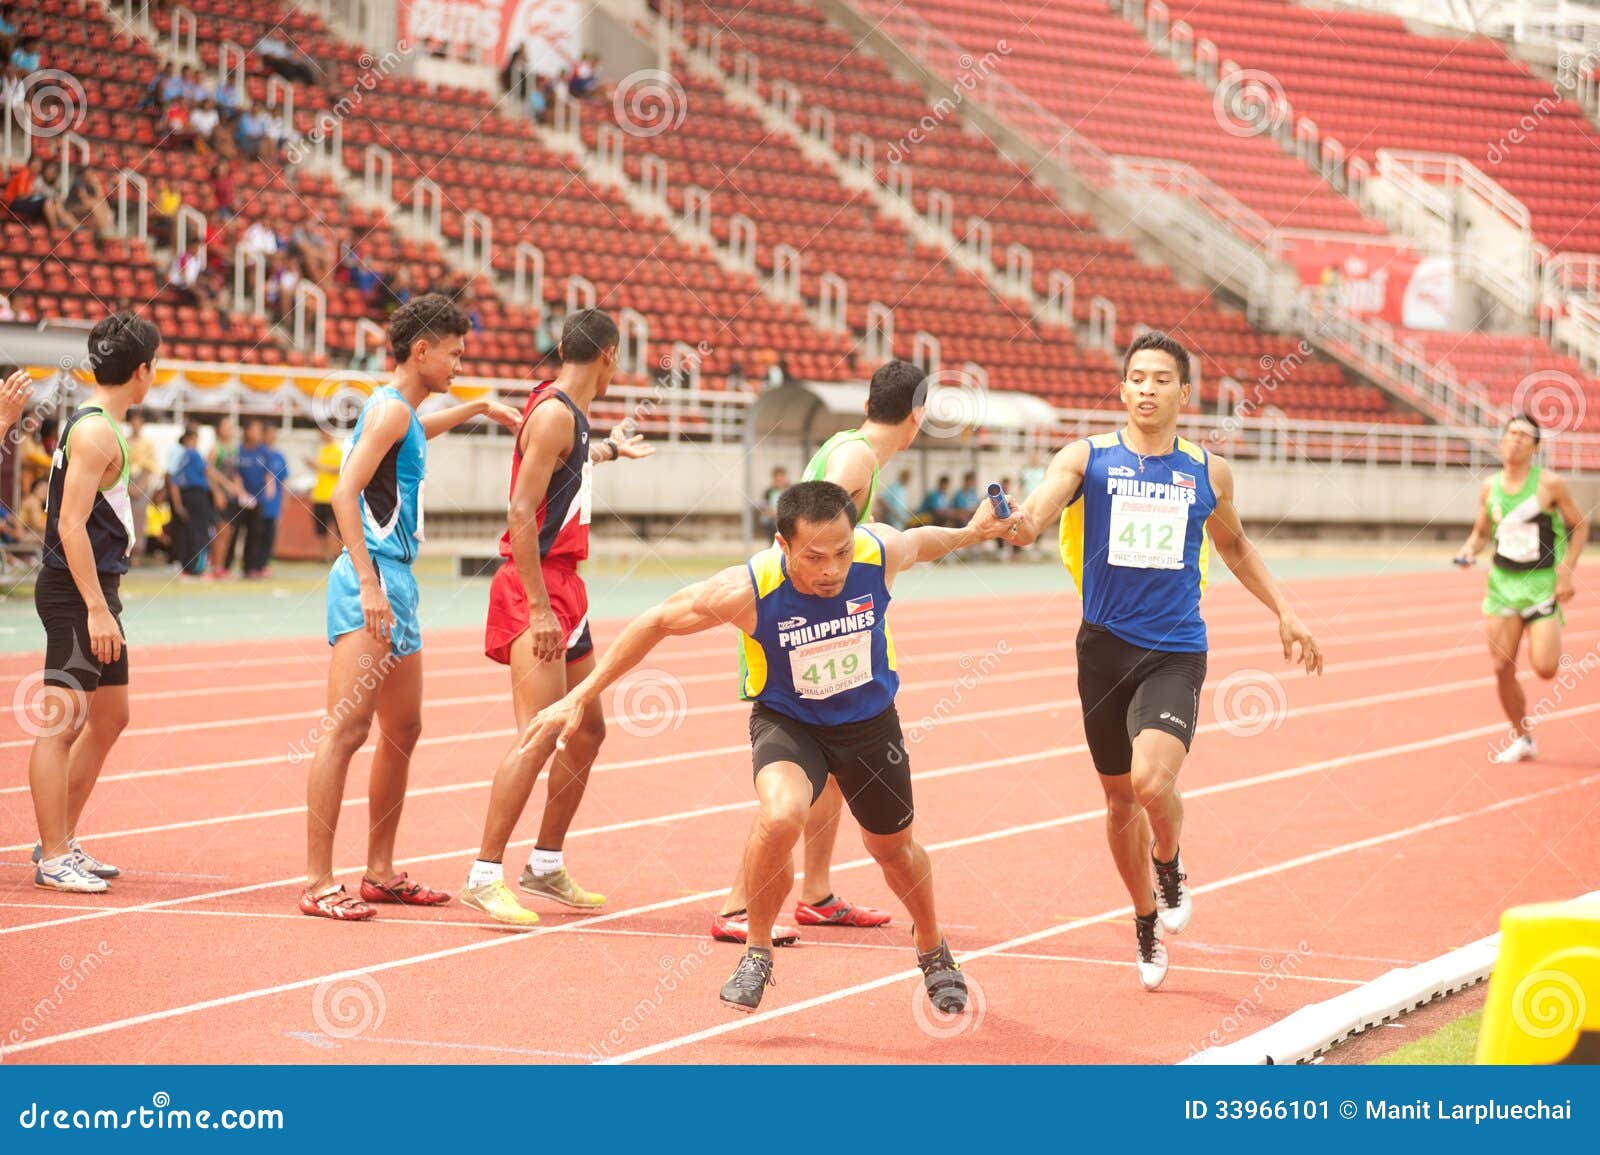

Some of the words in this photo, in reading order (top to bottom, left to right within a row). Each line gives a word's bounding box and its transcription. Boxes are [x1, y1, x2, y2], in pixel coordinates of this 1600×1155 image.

[1107, 477, 1196, 505] PHILIPPINES
[1118, 521, 1174, 551] 412
[779, 610, 875, 648] PHILIPPINES
[801, 653, 859, 685] 419
[800, 685, 834, 696] THAILAND
[835, 679, 853, 691] OPEN
